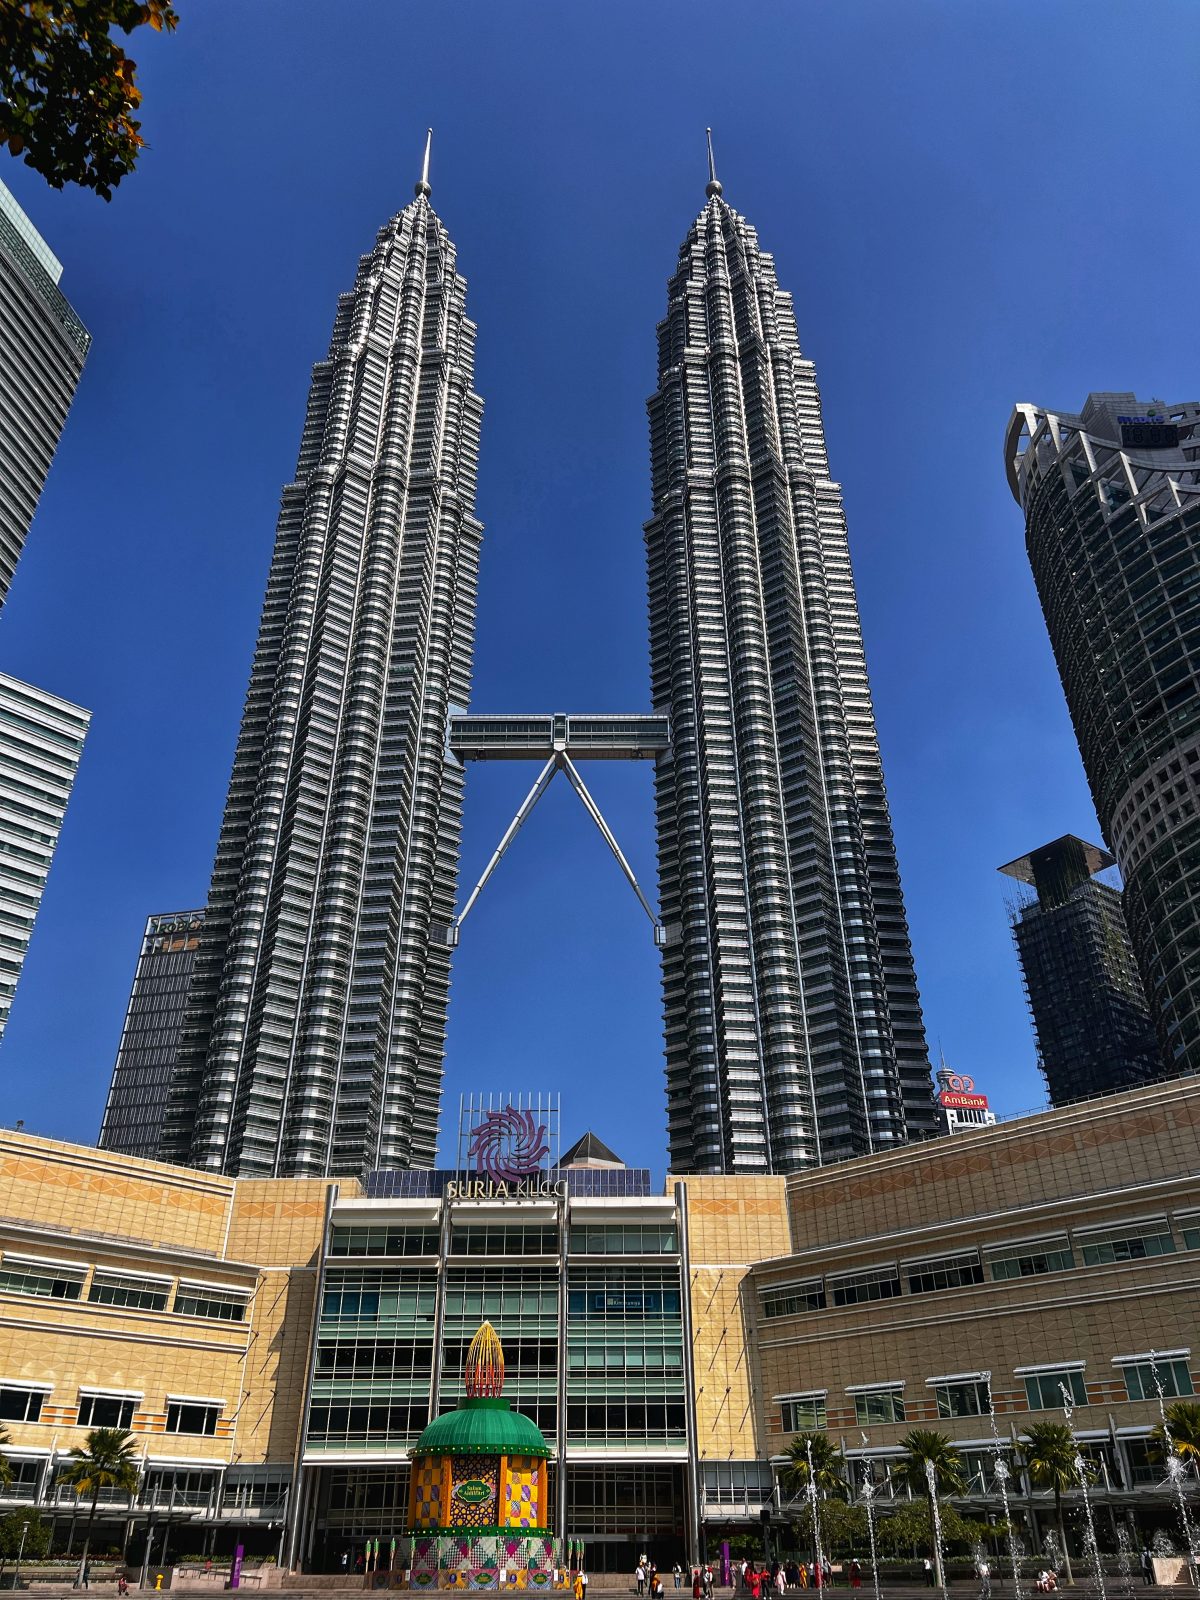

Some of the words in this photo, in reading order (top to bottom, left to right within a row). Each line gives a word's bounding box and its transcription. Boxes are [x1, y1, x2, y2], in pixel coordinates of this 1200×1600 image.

[944, 1095, 986, 1106] AmBank
[446, 1180, 509, 1198] SURIA
[517, 1180, 566, 1197] KLCC
